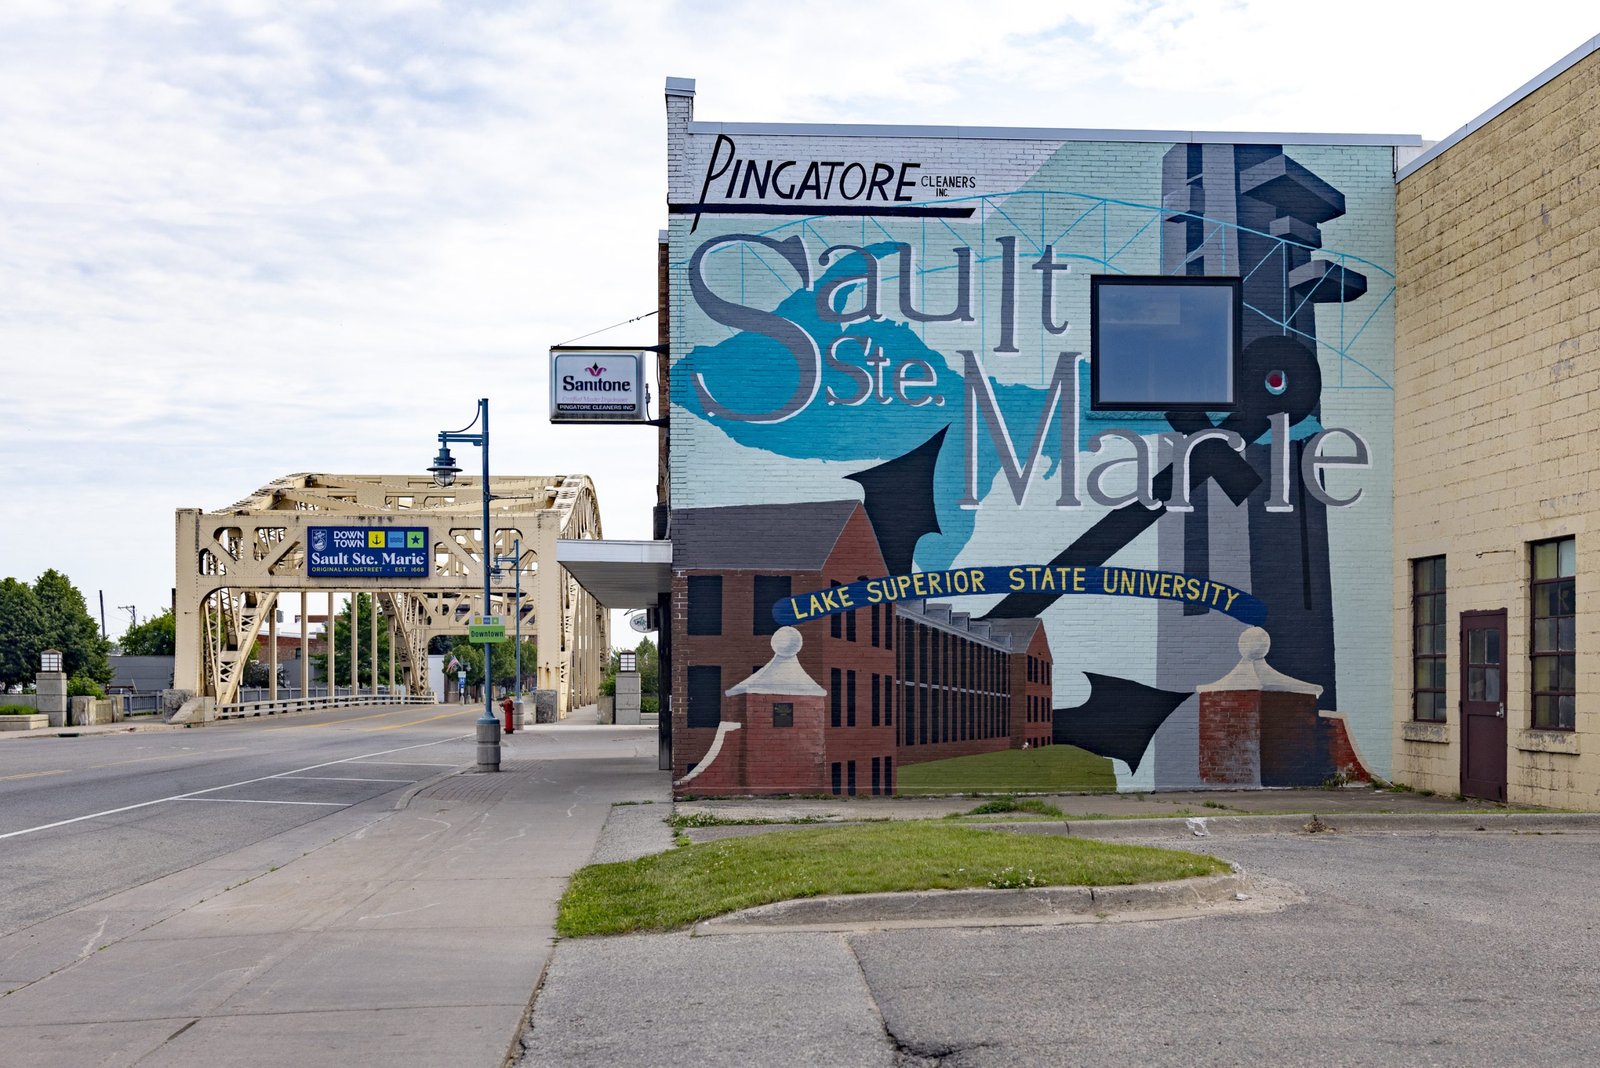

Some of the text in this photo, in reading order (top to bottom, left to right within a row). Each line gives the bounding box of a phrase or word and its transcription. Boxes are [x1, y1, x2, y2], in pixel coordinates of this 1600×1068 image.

[690, 133, 921, 235] PINGATORE
[920, 175, 976, 189] CLEANERS
[935, 188, 950, 197] INC.
[688, 233, 1070, 426] Sault
[825, 335, 945, 407] Ste.
[562, 375, 631, 392] Sanitone
[956, 349, 1374, 513] Marie
[333, 531, 365, 539] DOWN
[334, 540, 365, 548] TOWN
[311, 552, 349, 565] Sault
[352, 552, 378, 565] Ste.
[791, 567, 1240, 620] LAKE SUPERIOR STATE UNIVERSITY
[470, 630, 504, 638] Downtown
